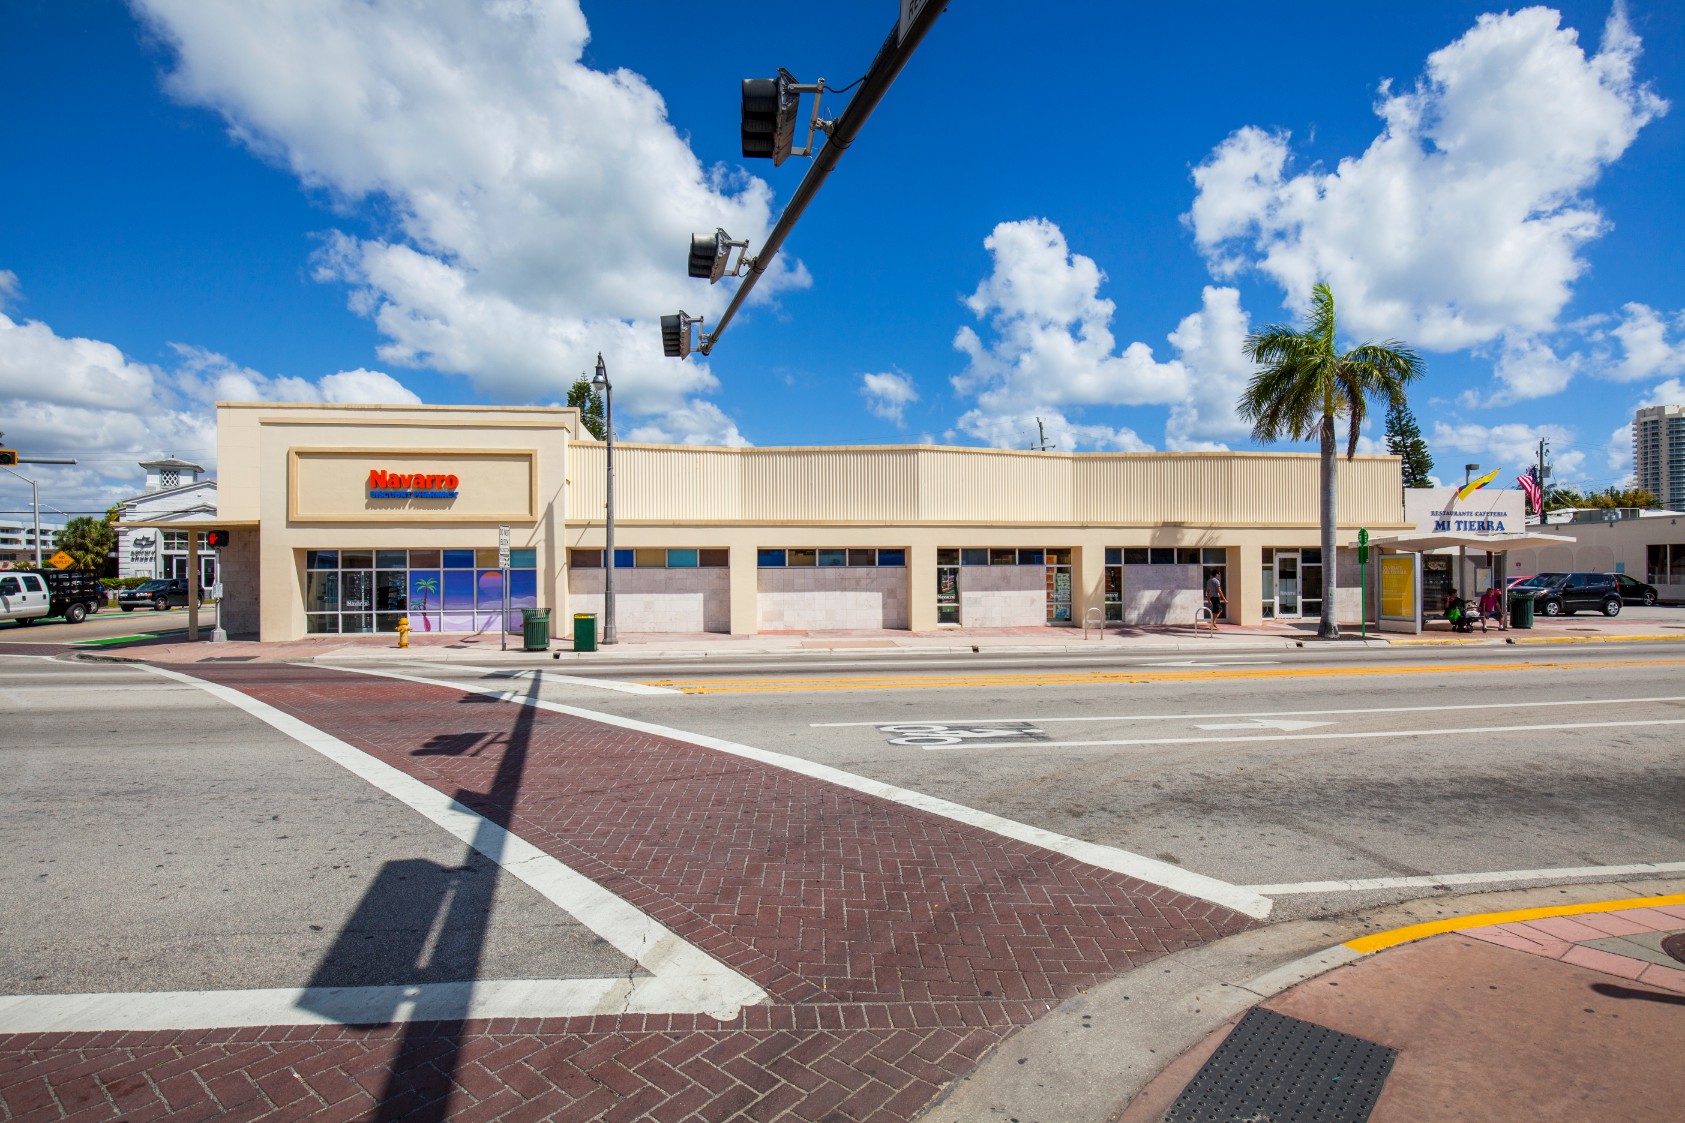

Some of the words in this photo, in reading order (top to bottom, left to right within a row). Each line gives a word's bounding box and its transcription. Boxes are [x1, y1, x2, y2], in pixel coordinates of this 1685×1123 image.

[370, 470, 459, 489] Navarro
[370, 491, 413, 499] DISCOUNT
[1435, 520, 1451, 531] MI
[1454, 520, 1505, 531] TIERRA
